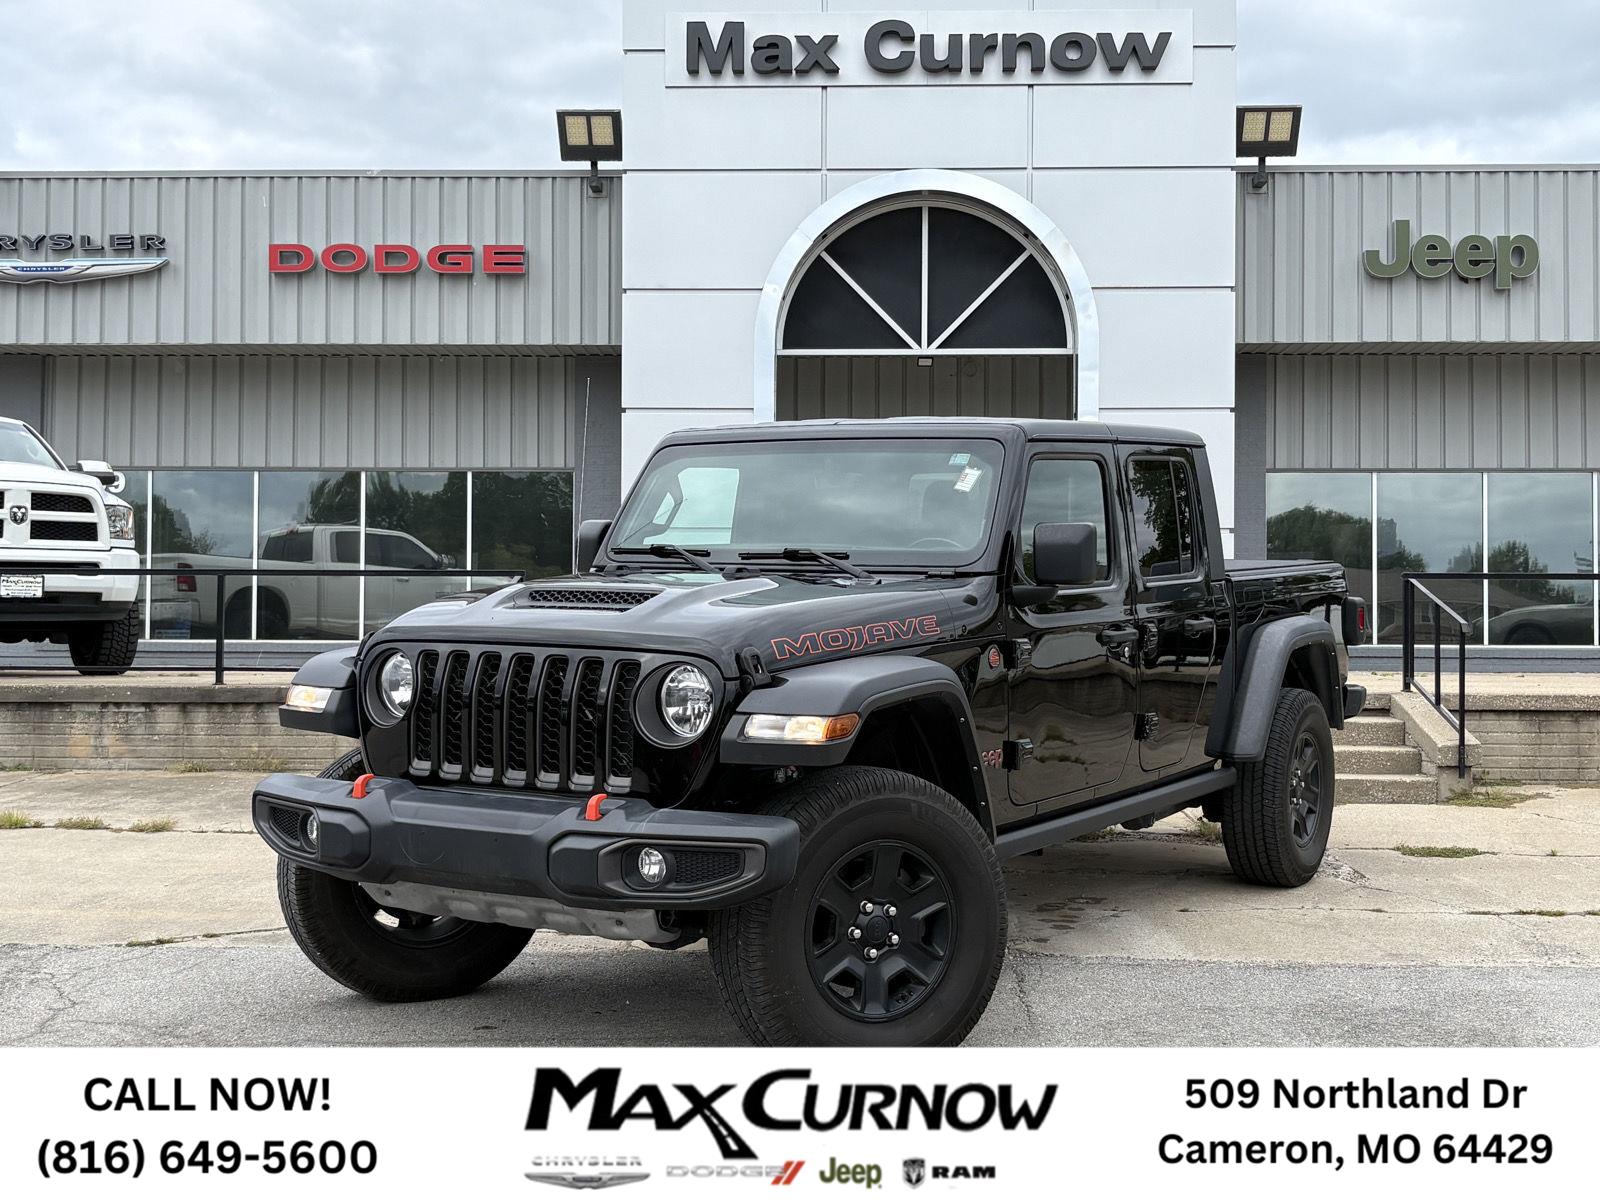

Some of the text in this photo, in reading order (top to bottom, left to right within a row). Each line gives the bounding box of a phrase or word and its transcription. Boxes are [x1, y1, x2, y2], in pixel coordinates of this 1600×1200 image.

[686, 19, 1173, 76] Max Curnow
[268, 243, 526, 274] DODGE
[1362, 219, 1540, 290] Jeep
[770, 615, 941, 660] MOJAVE
